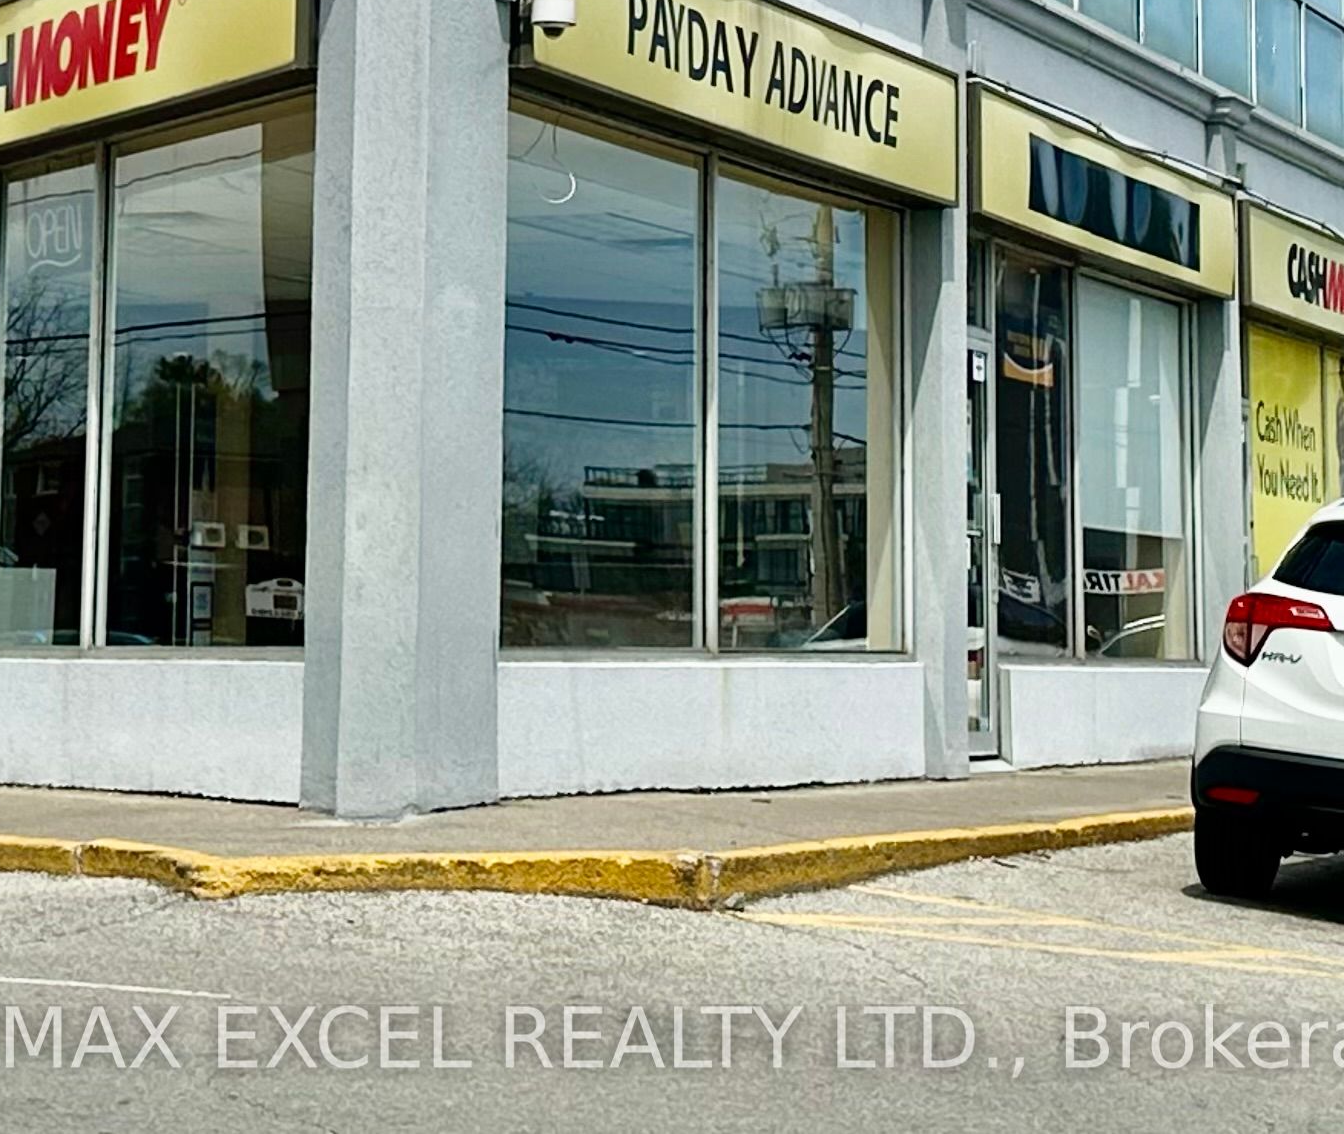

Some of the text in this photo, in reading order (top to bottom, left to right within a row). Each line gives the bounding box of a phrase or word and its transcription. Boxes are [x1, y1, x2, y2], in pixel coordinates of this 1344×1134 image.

[765, 42, 900, 149] ADVANCE
[26, 204, 83, 258] OPEN
[1257, 400, 1316, 452] Cash When
[1256, 454, 1279, 496] You
[1280, 459, 1309, 501] Need
